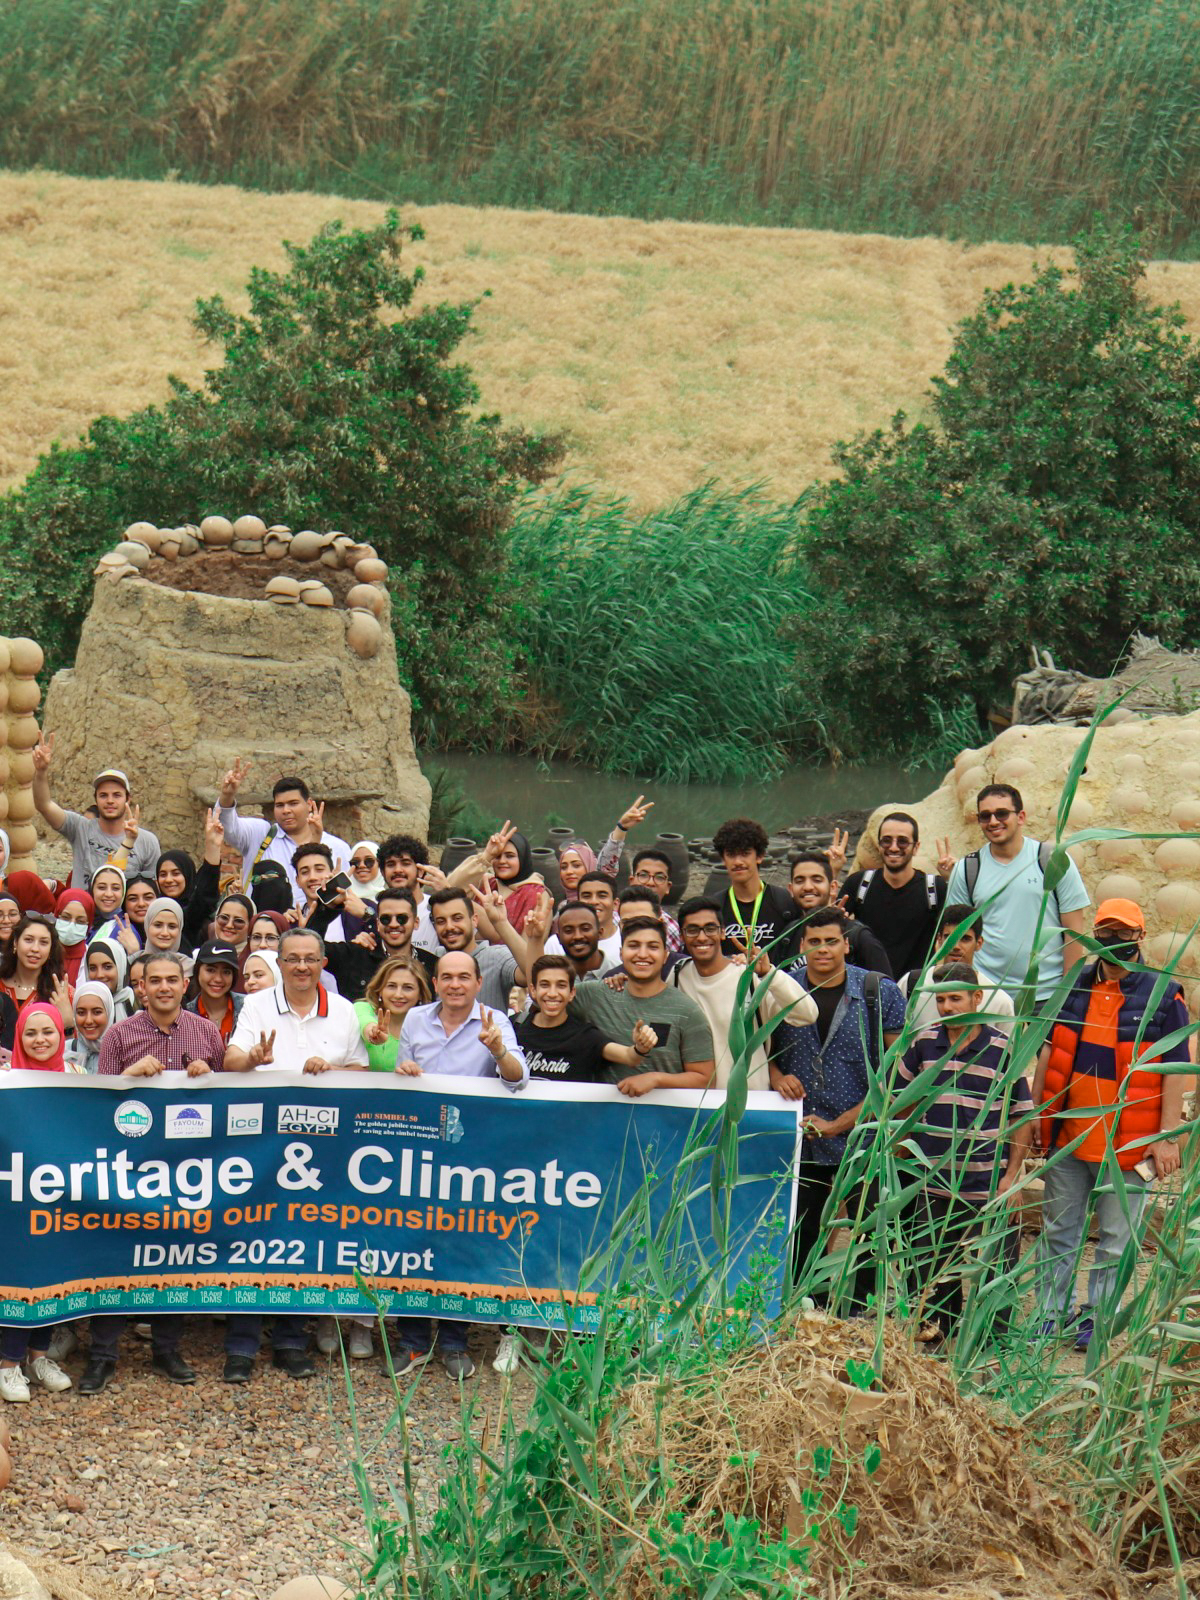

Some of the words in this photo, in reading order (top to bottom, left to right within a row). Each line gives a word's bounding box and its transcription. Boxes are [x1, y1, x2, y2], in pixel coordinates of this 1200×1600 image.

[525, 1050, 570, 1073] lifornia
[281, 1108, 336, 1124] AH-CI
[173, 1119, 204, 1128] FAYOUM
[231, 1117, 259, 1129] ice
[388, 1122, 409, 1130] jubilee
[410, 1124, 439, 1132] campaign
[279, 1123, 338, 1135] EGYPT
[416, 1132, 440, 1140] temples
[276, 1142, 324, 1191] &
[347, 1145, 602, 1208] Climate
[30, 1204, 212, 1235] Discussing
[223, 1202, 278, 1226] our
[287, 1202, 540, 1240] responsibility?
[133, 1242, 218, 1267] IDMS
[228, 1239, 306, 1264] 2022
[336, 1241, 435, 1276] Egypt
[74, 1296, 87, 1304] April
[100, 1298, 120, 1306] IDMS
[167, 1296, 188, 1304] IDMS
[338, 1297, 359, 1305] IDMS
[407, 1300, 428, 1308] IDMS
[44, 1302, 57, 1311] April
[68, 1302, 87, 1311] IDMS
[441, 1303, 462, 1311] IDMS
[476, 1306, 497, 1315] IDMS
[4, 1309, 25, 1318] IDMS
[38, 1308, 57, 1317] IDMS
